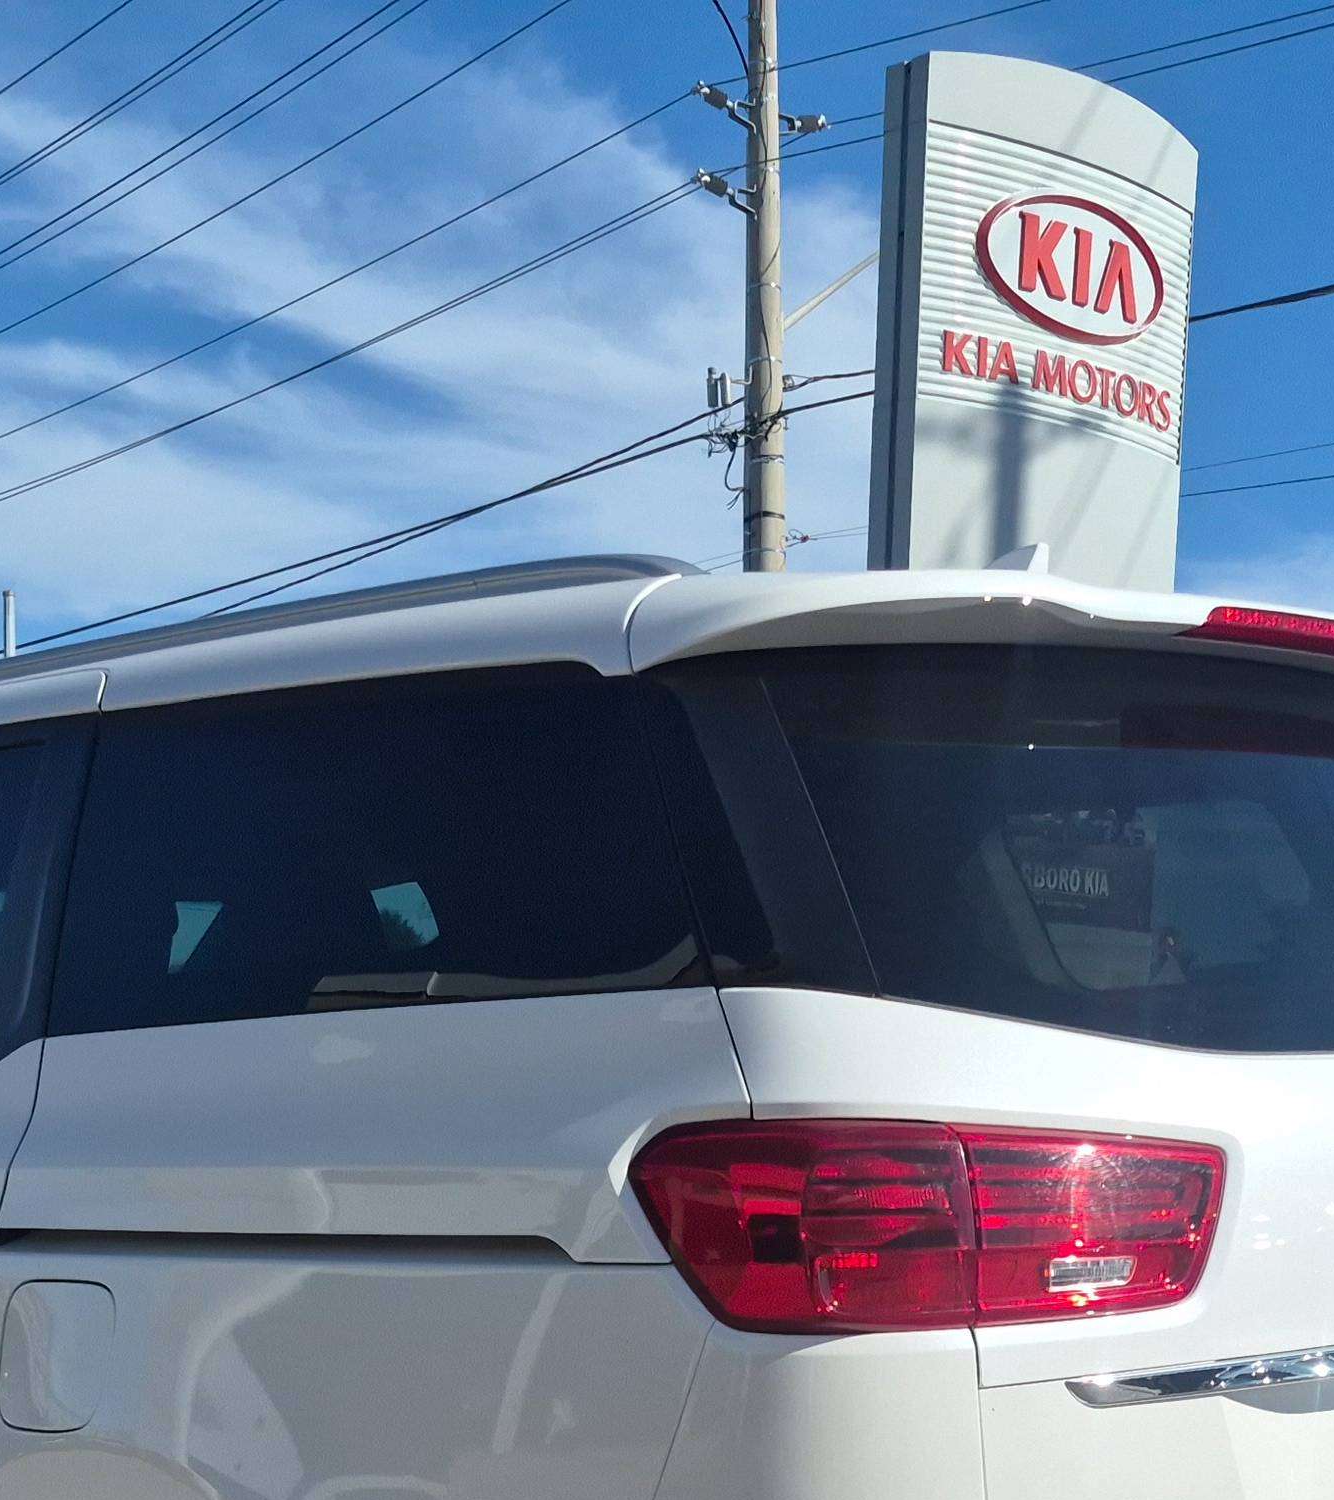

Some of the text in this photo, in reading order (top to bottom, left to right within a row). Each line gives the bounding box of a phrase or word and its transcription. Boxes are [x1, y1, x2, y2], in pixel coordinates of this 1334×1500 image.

[1018, 211, 1138, 325] KIA
[941, 329, 1172, 433] KIA MOTORS
[1083, 869, 1110, 897] KIA
